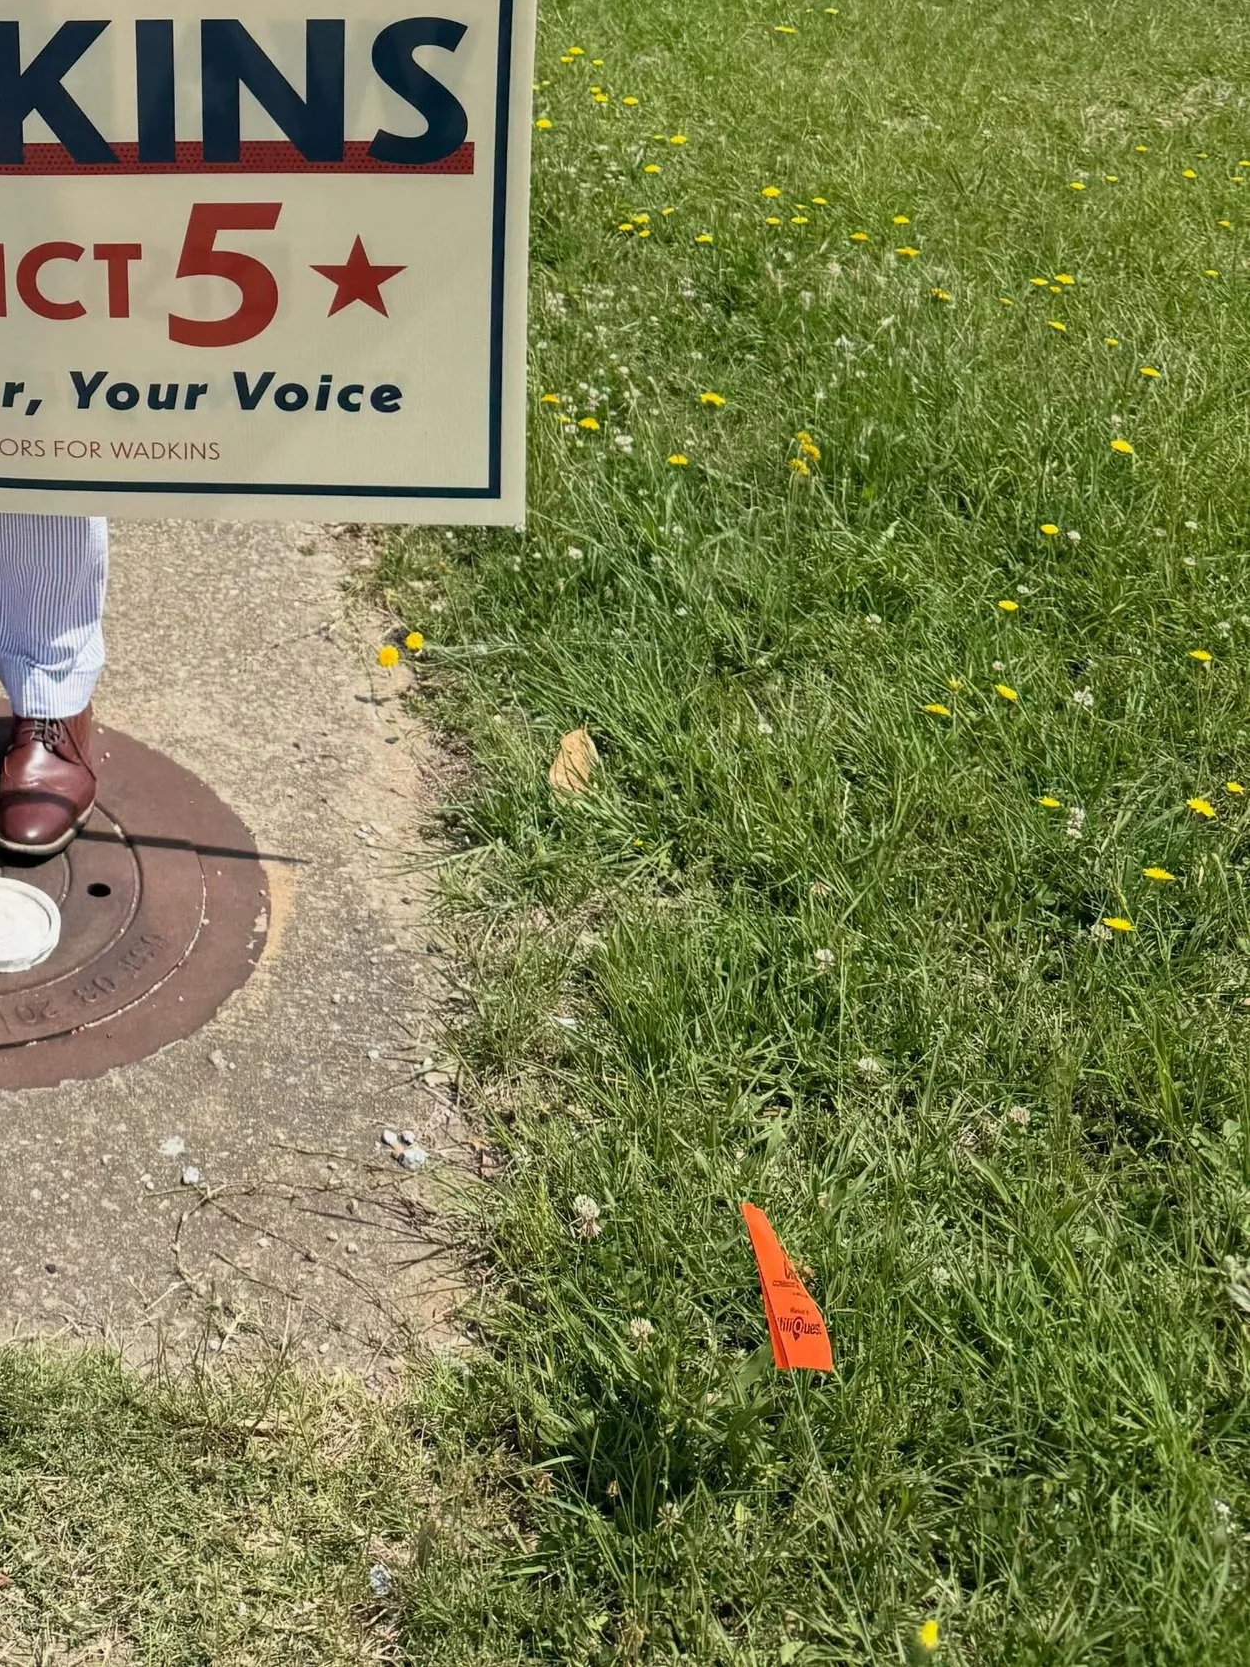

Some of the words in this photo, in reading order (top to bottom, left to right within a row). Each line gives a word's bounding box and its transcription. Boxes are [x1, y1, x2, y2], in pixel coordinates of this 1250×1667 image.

[168, 202, 283, 348] 5
[69, 370, 209, 411] Your
[233, 371, 403, 414] Voice
[53, 440, 102, 460] FOR
[110, 442, 221, 462] WADKINS
